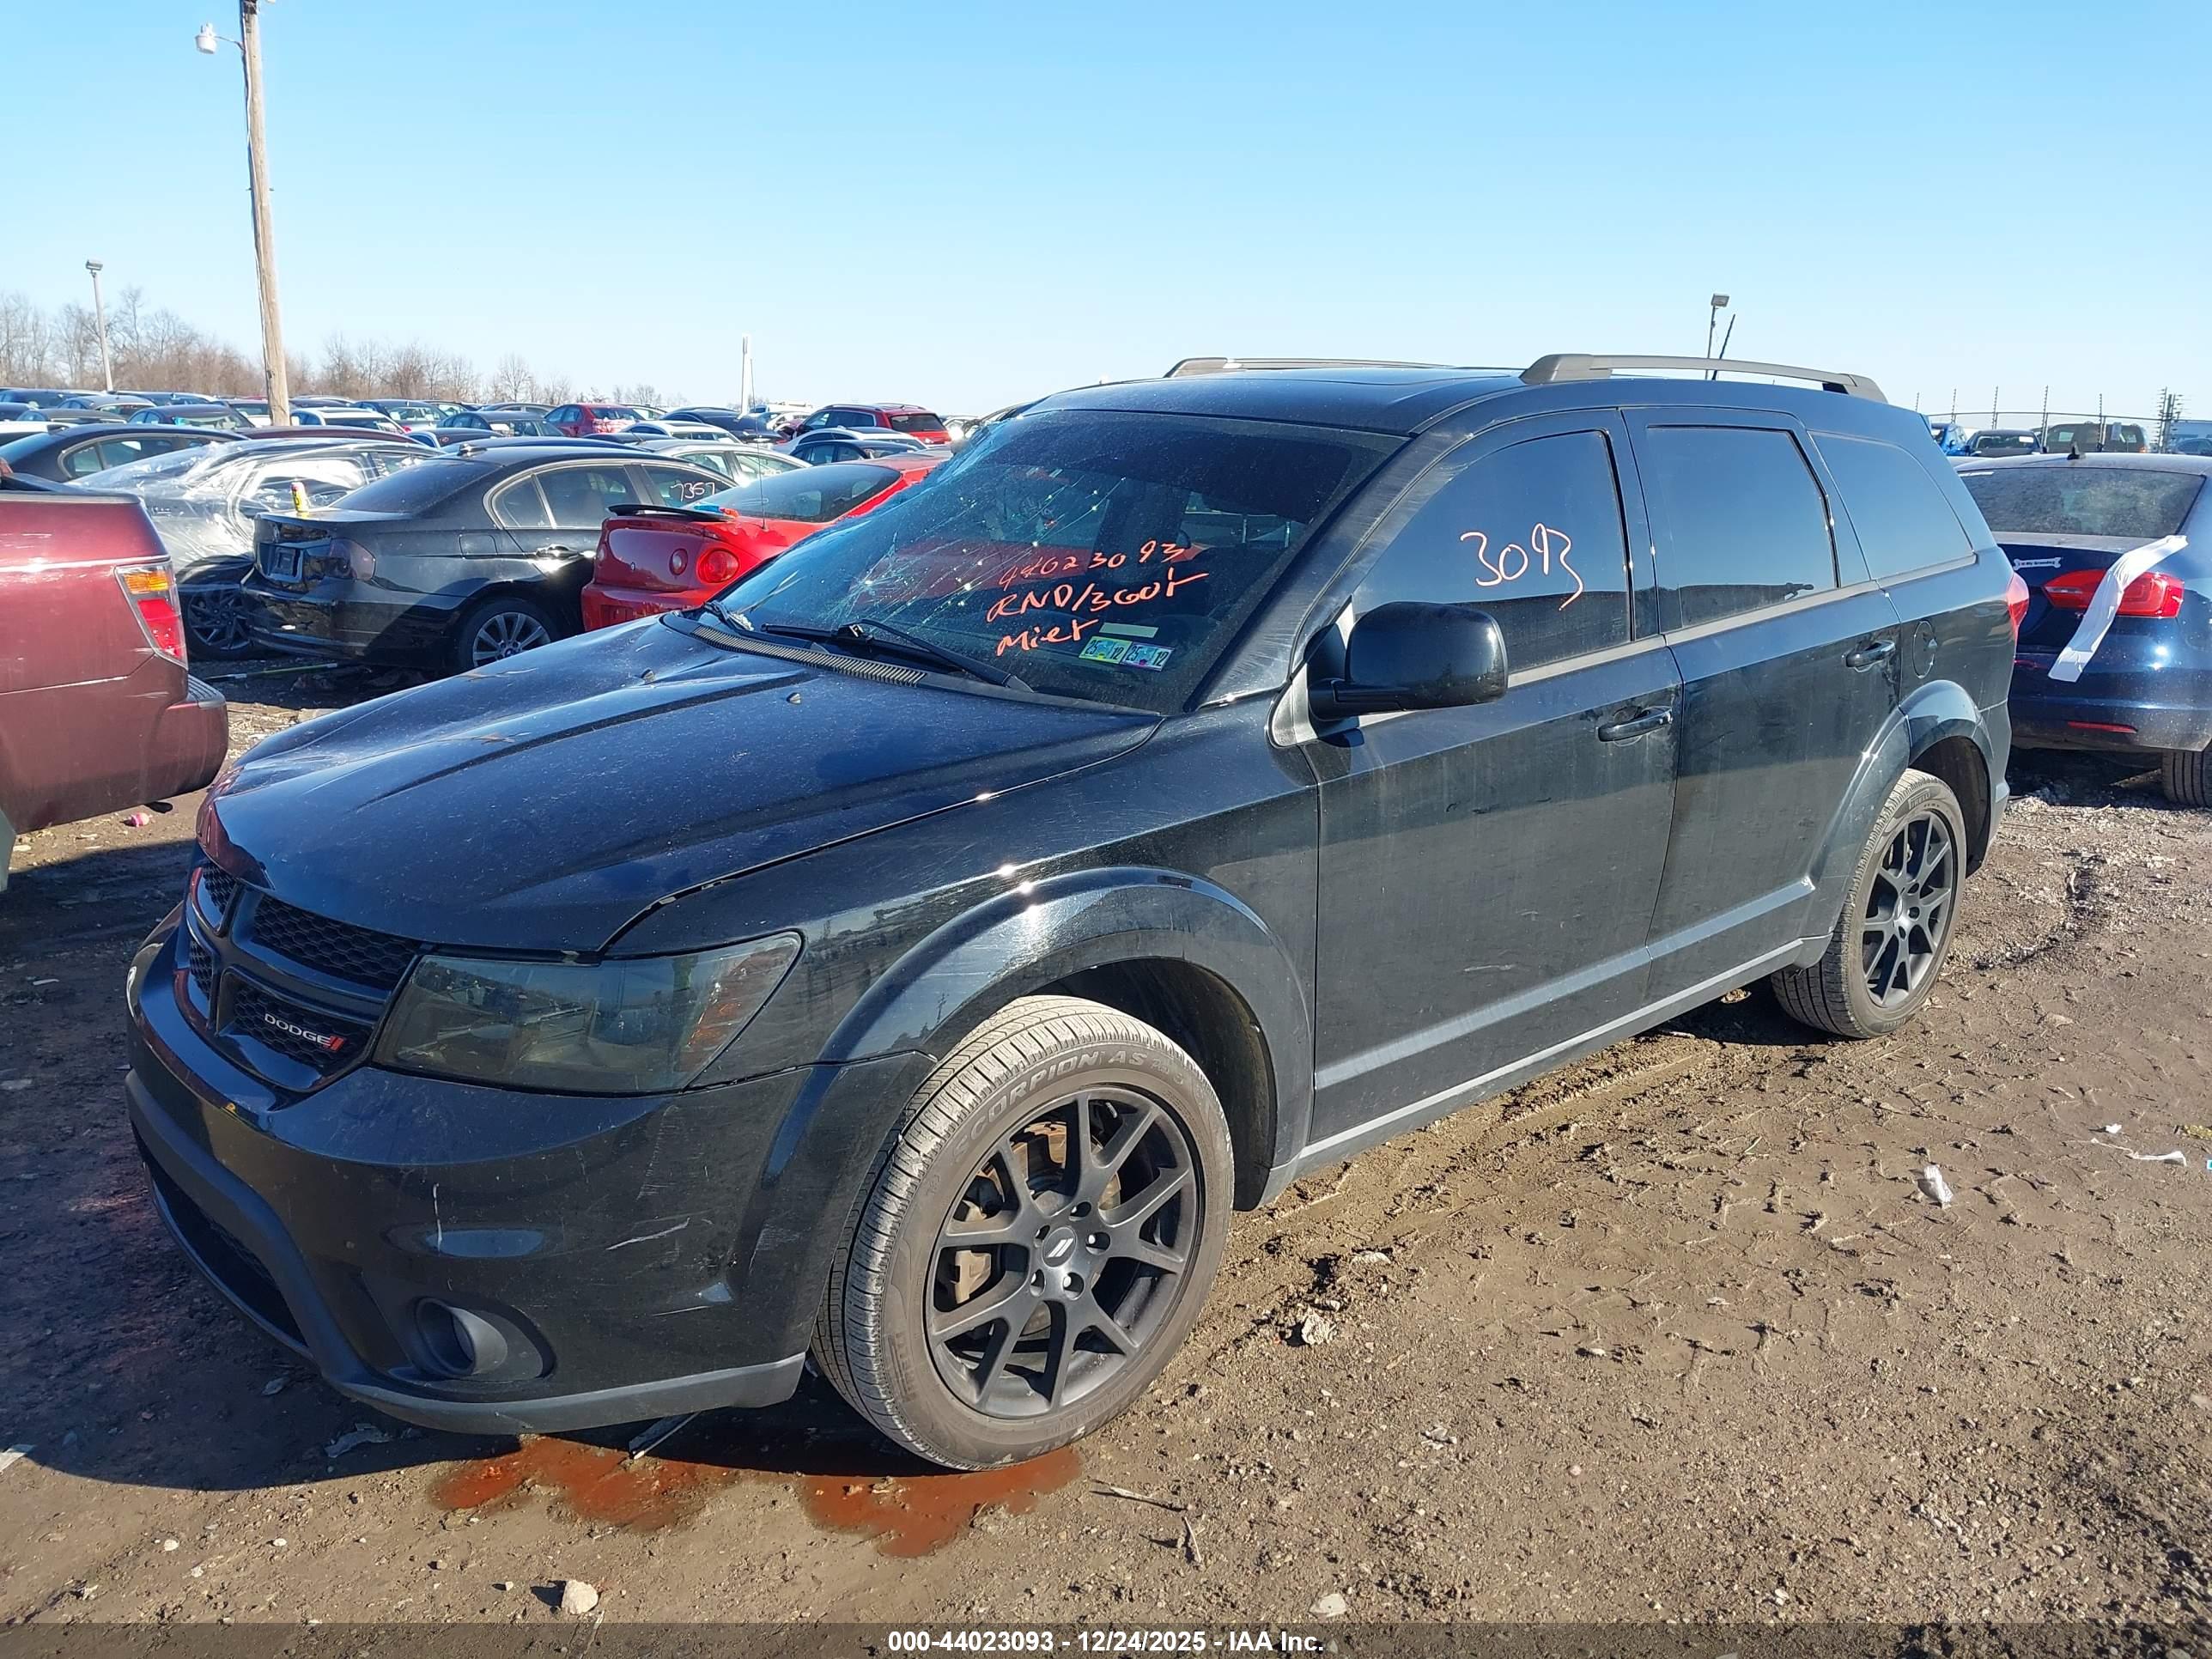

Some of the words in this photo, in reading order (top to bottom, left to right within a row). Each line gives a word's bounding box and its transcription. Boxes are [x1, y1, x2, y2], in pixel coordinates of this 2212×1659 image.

[1459, 522, 1584, 611] 3093
[1085, 639, 1102, 655] 25
[1109, 647, 1125, 660] 12
[1126, 645, 1143, 661] 25
[1152, 650, 1170, 666] 12
[264, 1013, 331, 1048] DODGE
[952, 1050, 1099, 1157] SCORPION
[1108, 1049, 1148, 1066] AS
